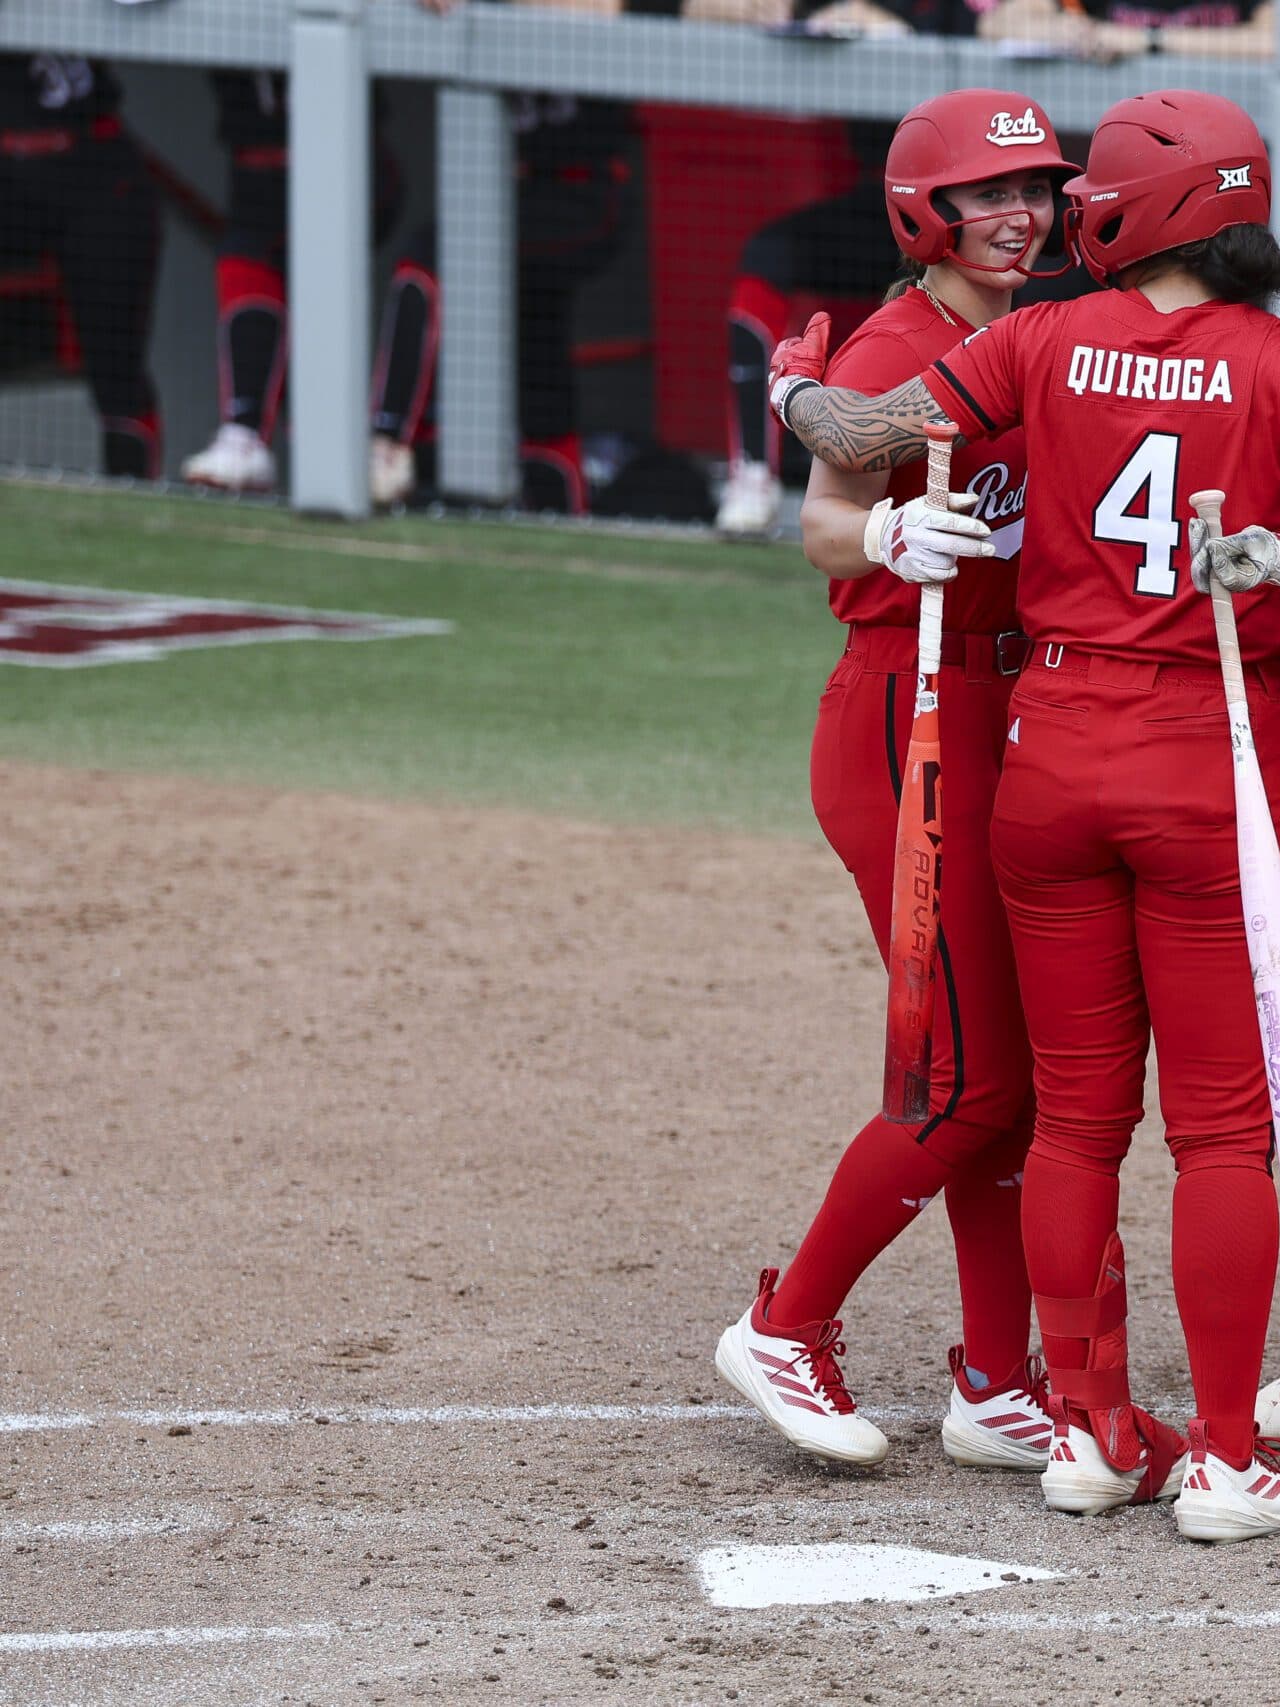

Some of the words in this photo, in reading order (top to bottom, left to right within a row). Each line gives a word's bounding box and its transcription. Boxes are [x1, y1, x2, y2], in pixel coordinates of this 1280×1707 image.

[986, 107, 1046, 147] Tech
[891, 185, 916, 195] EASTON
[1090, 191, 1119, 202] EASTON
[1216, 163, 1251, 192] XII
[1067, 345, 1233, 403] QUIROGA
[966, 462, 1029, 520] Red
[1091, 430, 1181, 598] 4
